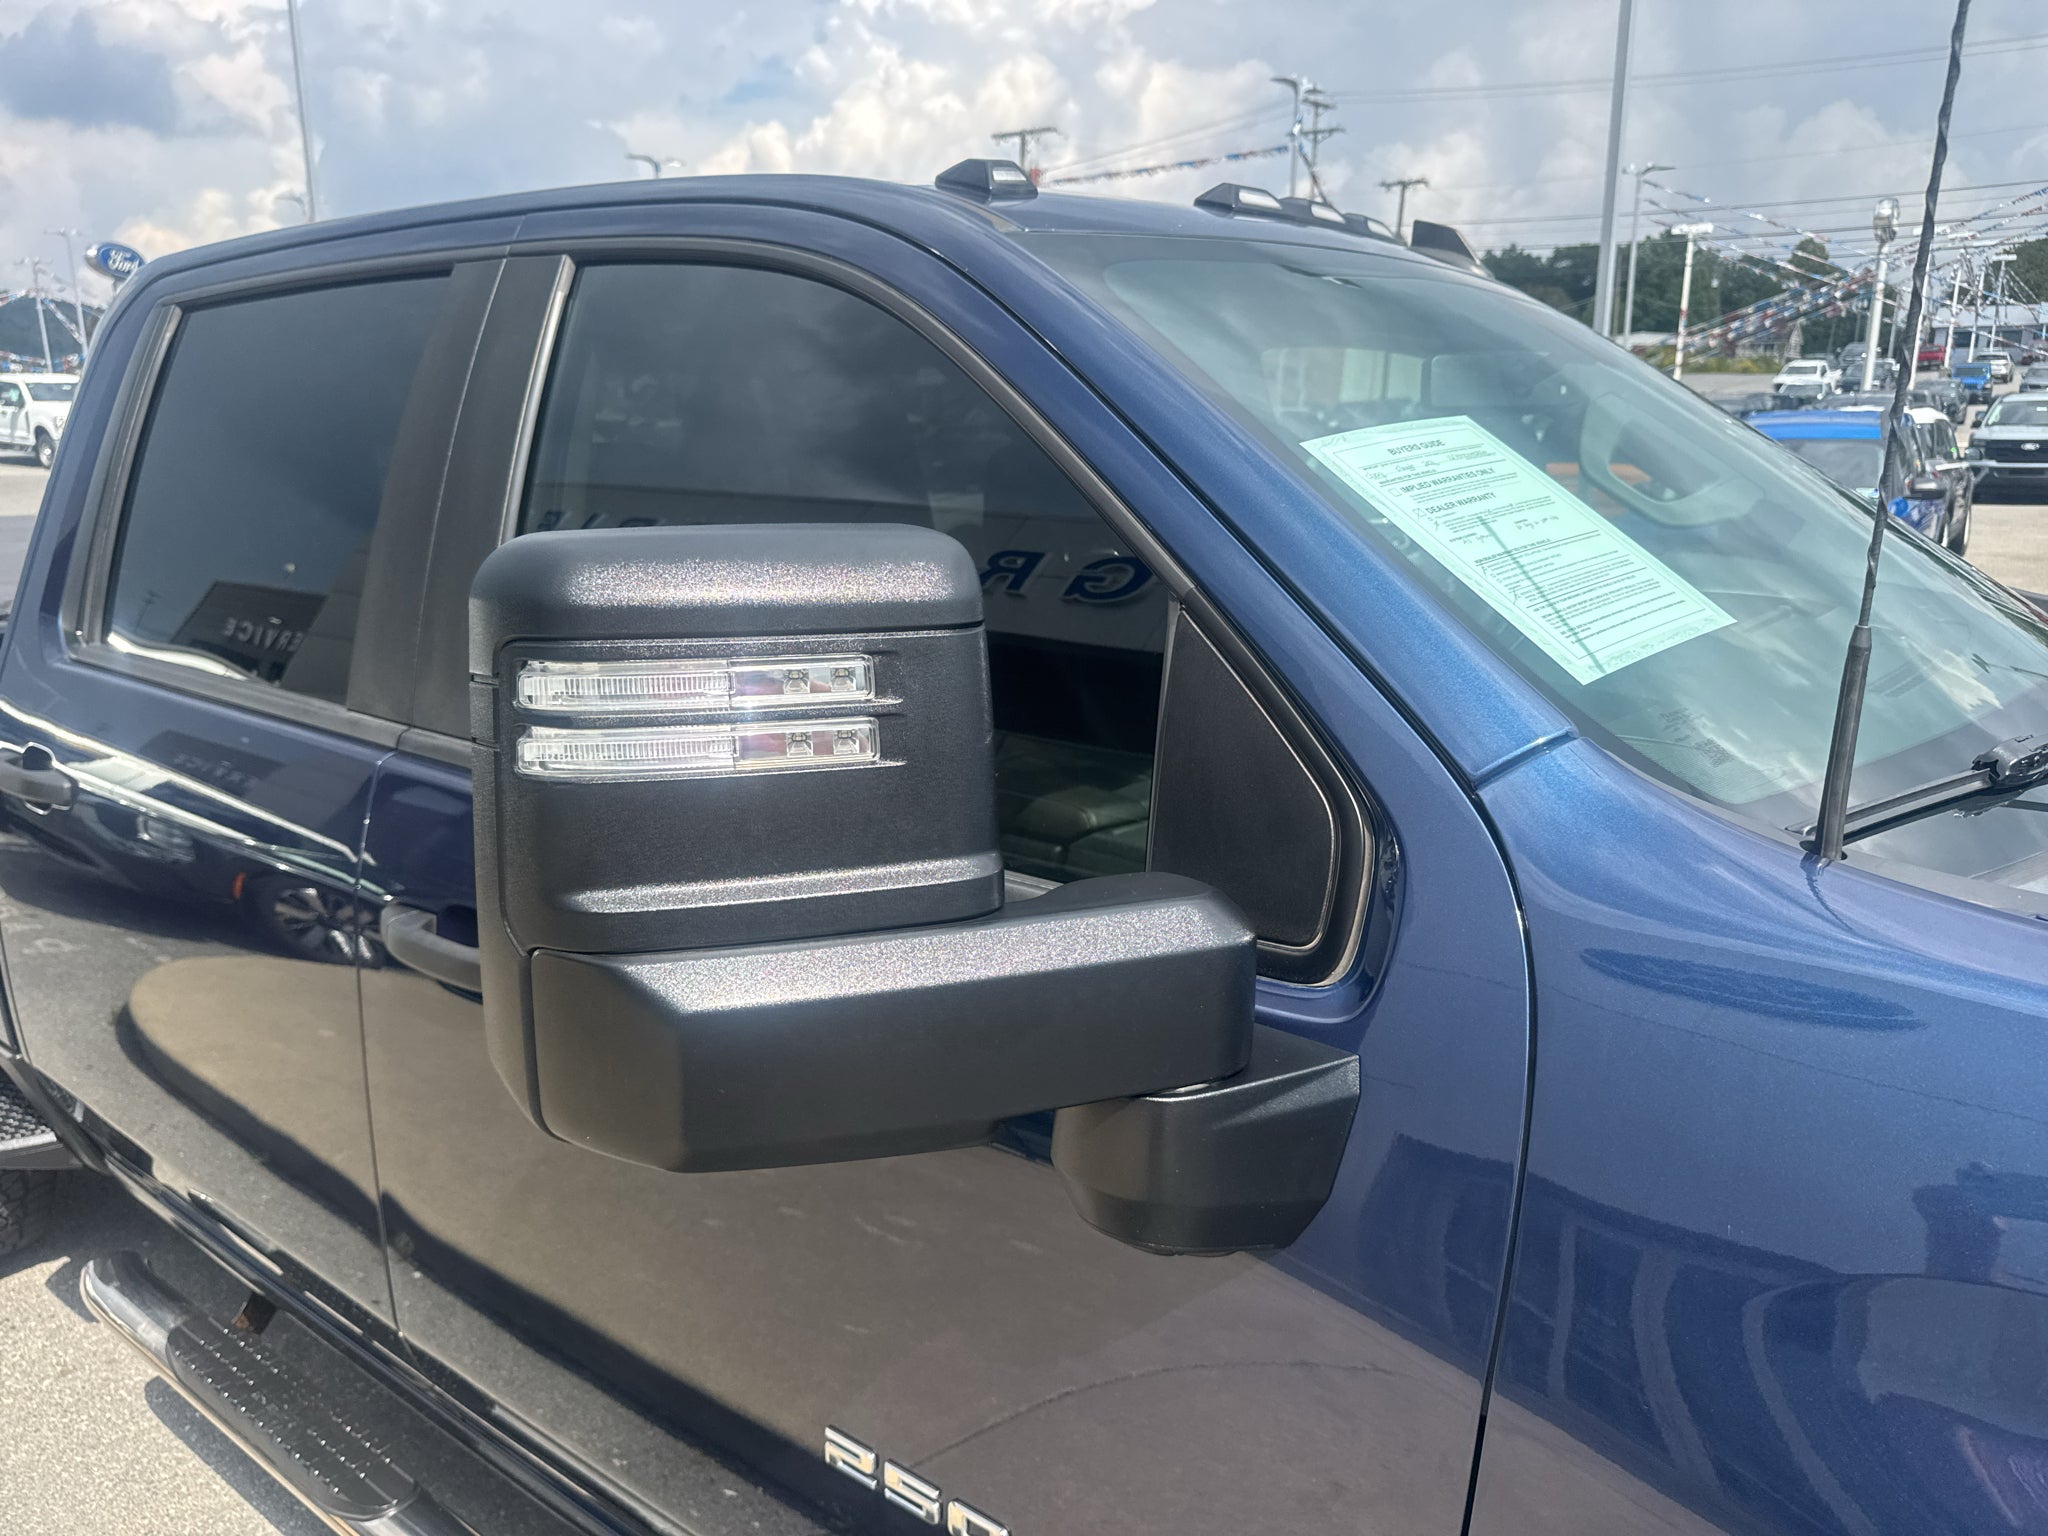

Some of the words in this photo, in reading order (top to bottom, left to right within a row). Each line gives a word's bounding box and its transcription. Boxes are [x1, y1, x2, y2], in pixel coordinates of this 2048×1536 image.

[107, 248, 140, 273] Ford
[1387, 443, 1421, 455] BUYERS
[1420, 439, 1446, 449] GUIDE
[1400, 481, 1432, 493] IMPLIED
[1430, 471, 1477, 486] WARRANTIES
[1475, 467, 1495, 476] ONLY
[1425, 501, 1458, 514] DEALER
[1455, 492, 1497, 506] WARRANTY
[824, 1425, 1013, 1536] 250
